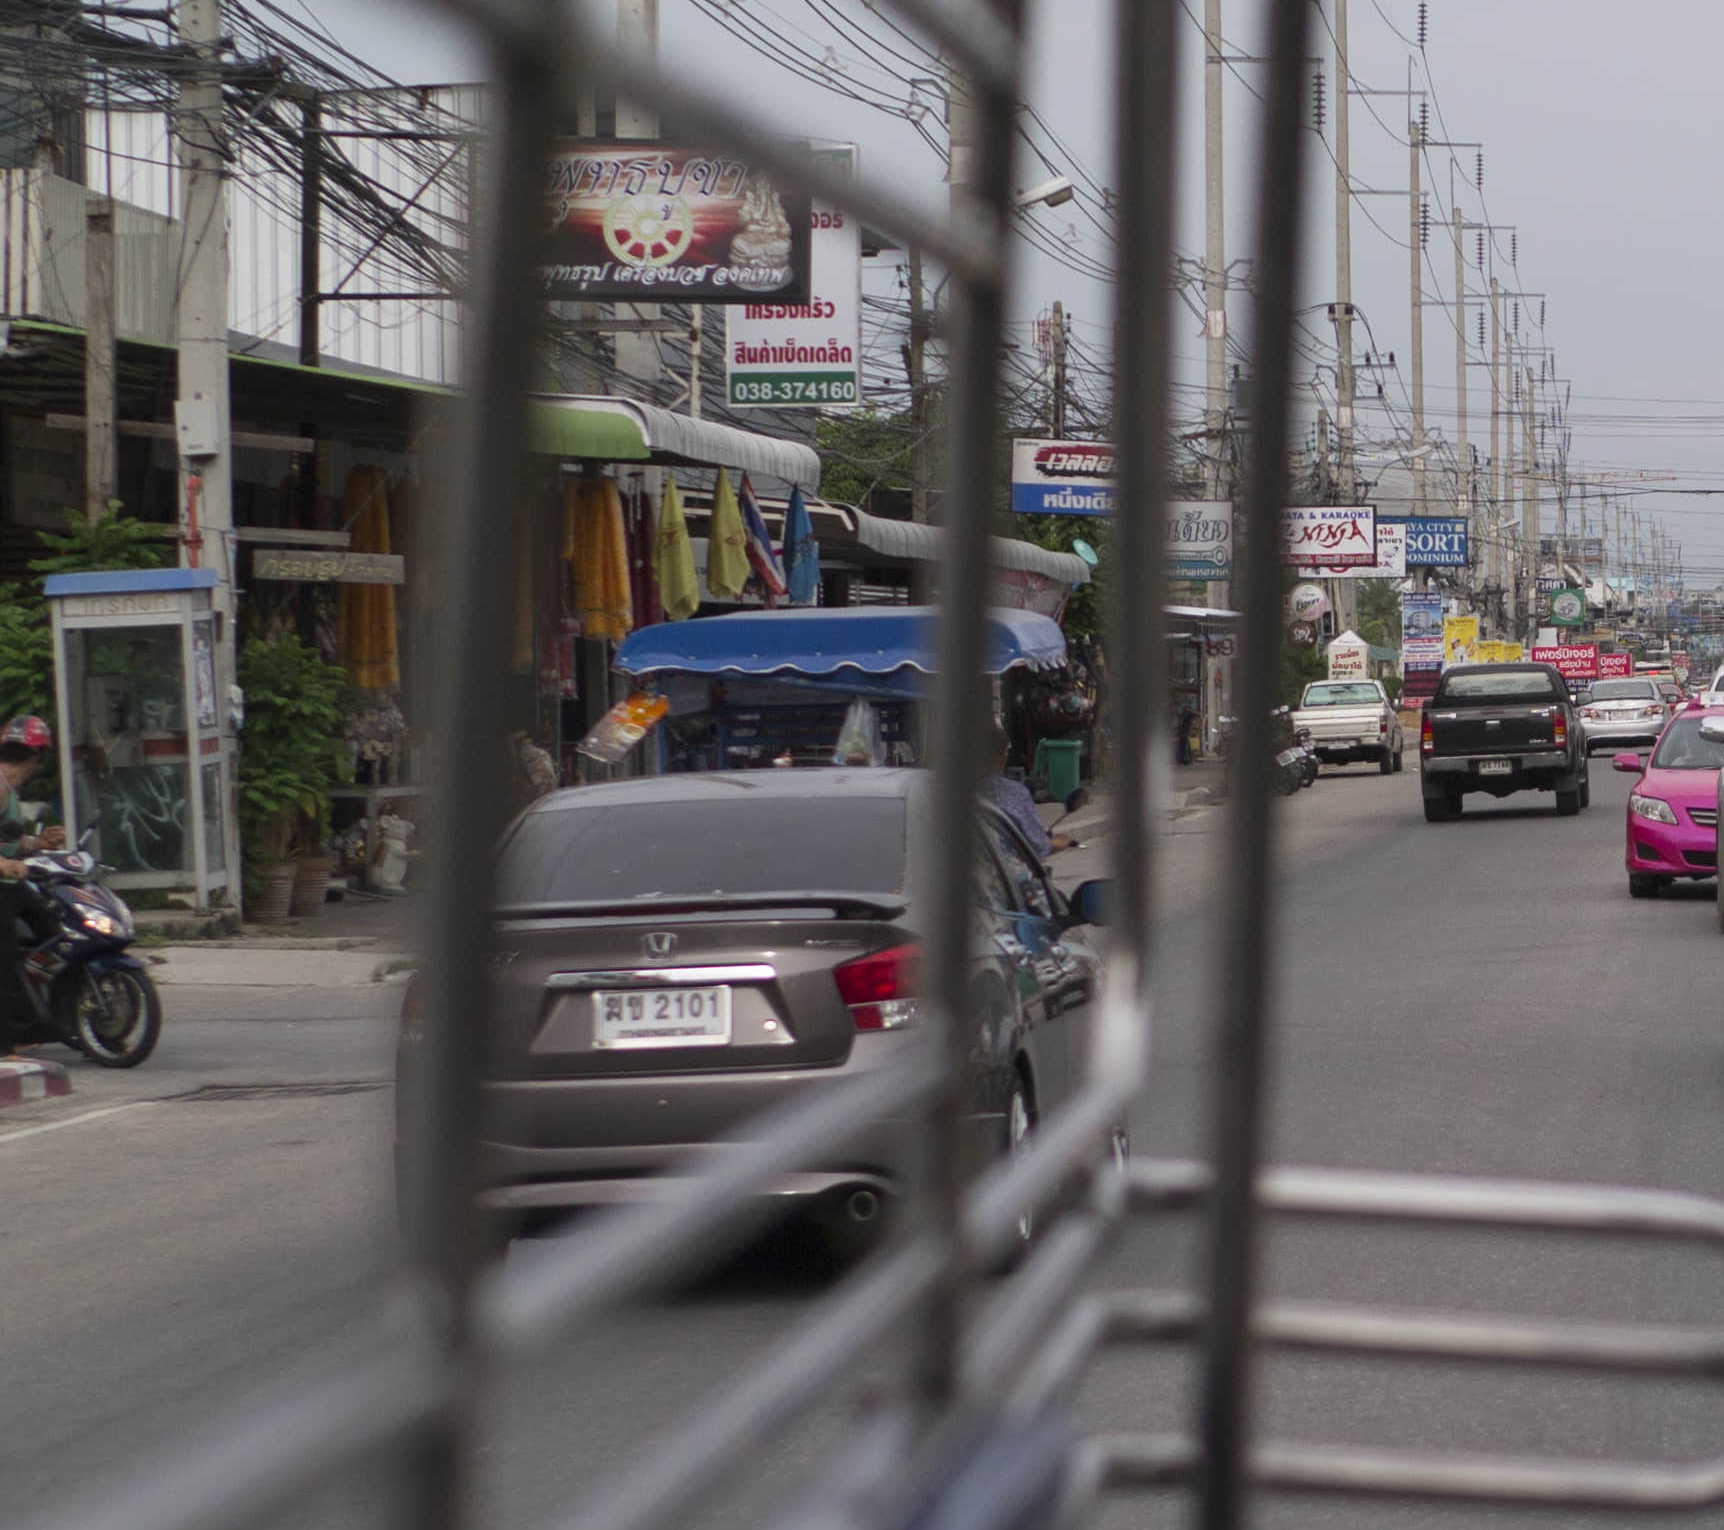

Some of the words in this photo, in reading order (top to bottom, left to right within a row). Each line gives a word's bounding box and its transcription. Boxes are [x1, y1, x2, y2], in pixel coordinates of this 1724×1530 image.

[735, 381, 855, 401] 038-374160
[1321, 511, 1371, 519] KARAOKE
[1427, 523, 1454, 533] CITY
[1407, 533, 1465, 552] SORT
[1406, 553, 1465, 563] OMINIUM
[655, 992, 720, 1020] 2101
